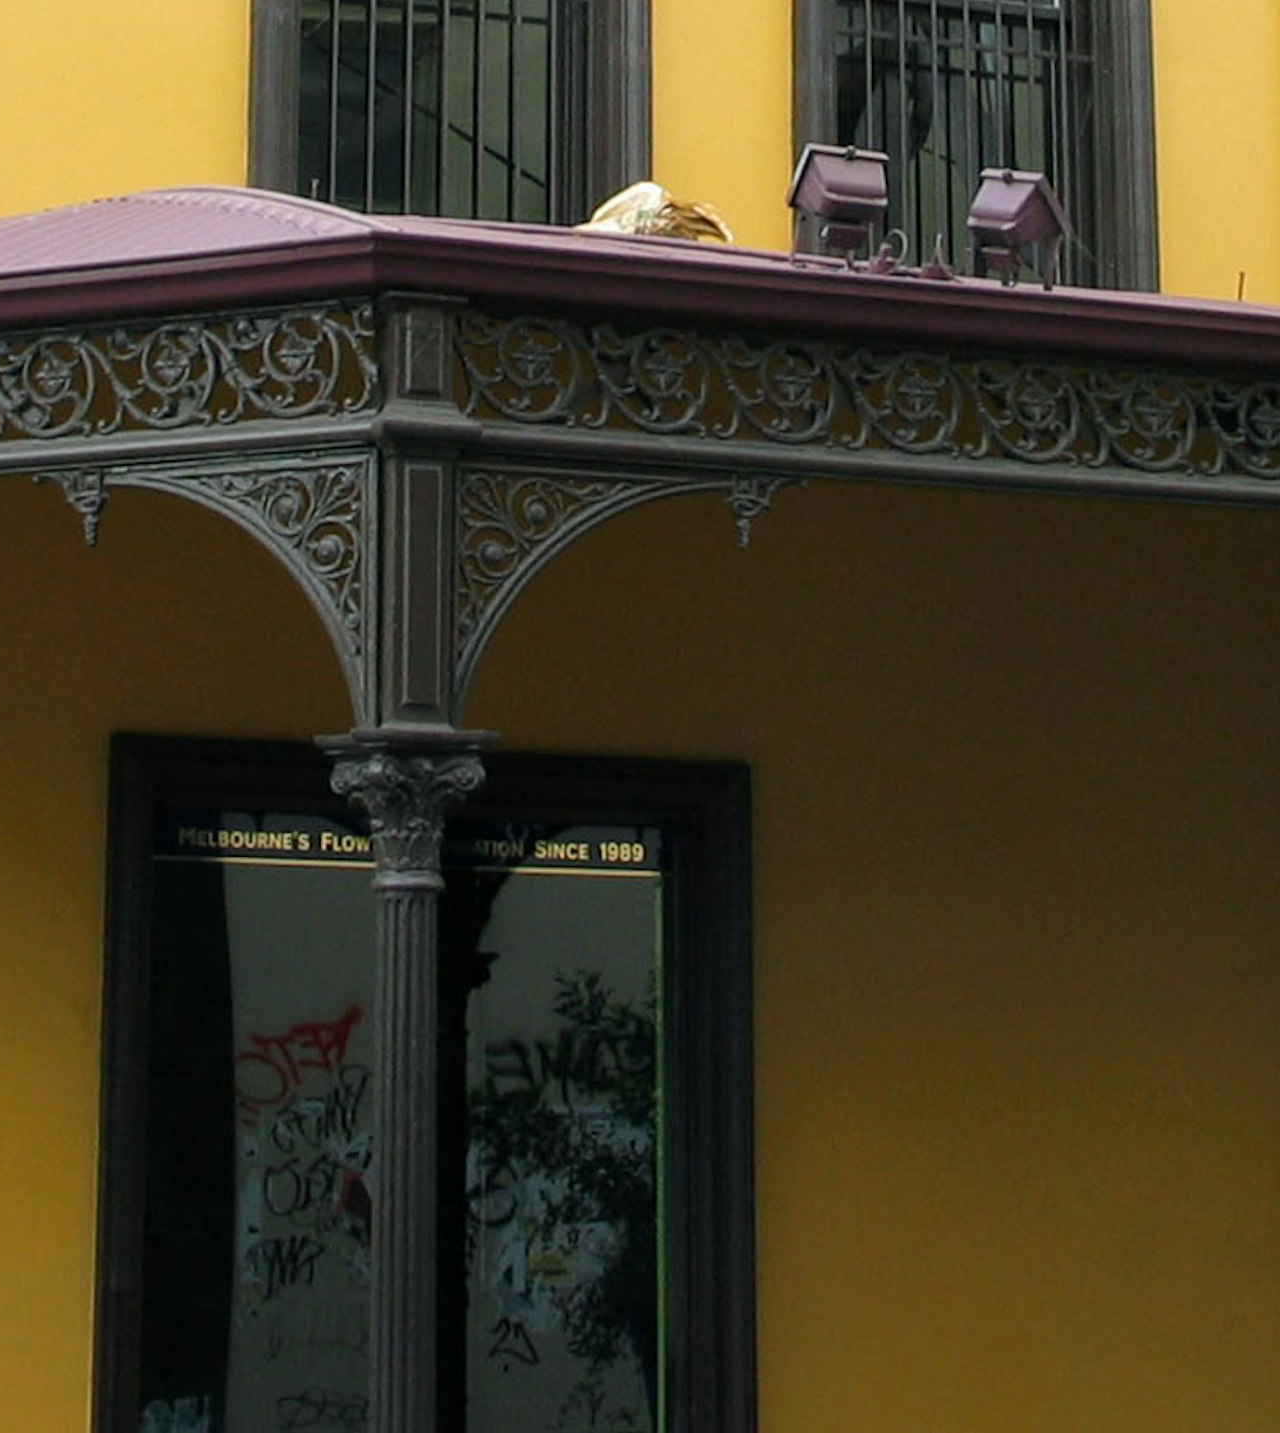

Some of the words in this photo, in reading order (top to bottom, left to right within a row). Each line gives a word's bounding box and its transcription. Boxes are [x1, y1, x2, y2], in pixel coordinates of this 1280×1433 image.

[318, 830, 373, 854] FLOW
[533, 839, 591, 862] SINCE
[598, 842, 645, 864] 1989
